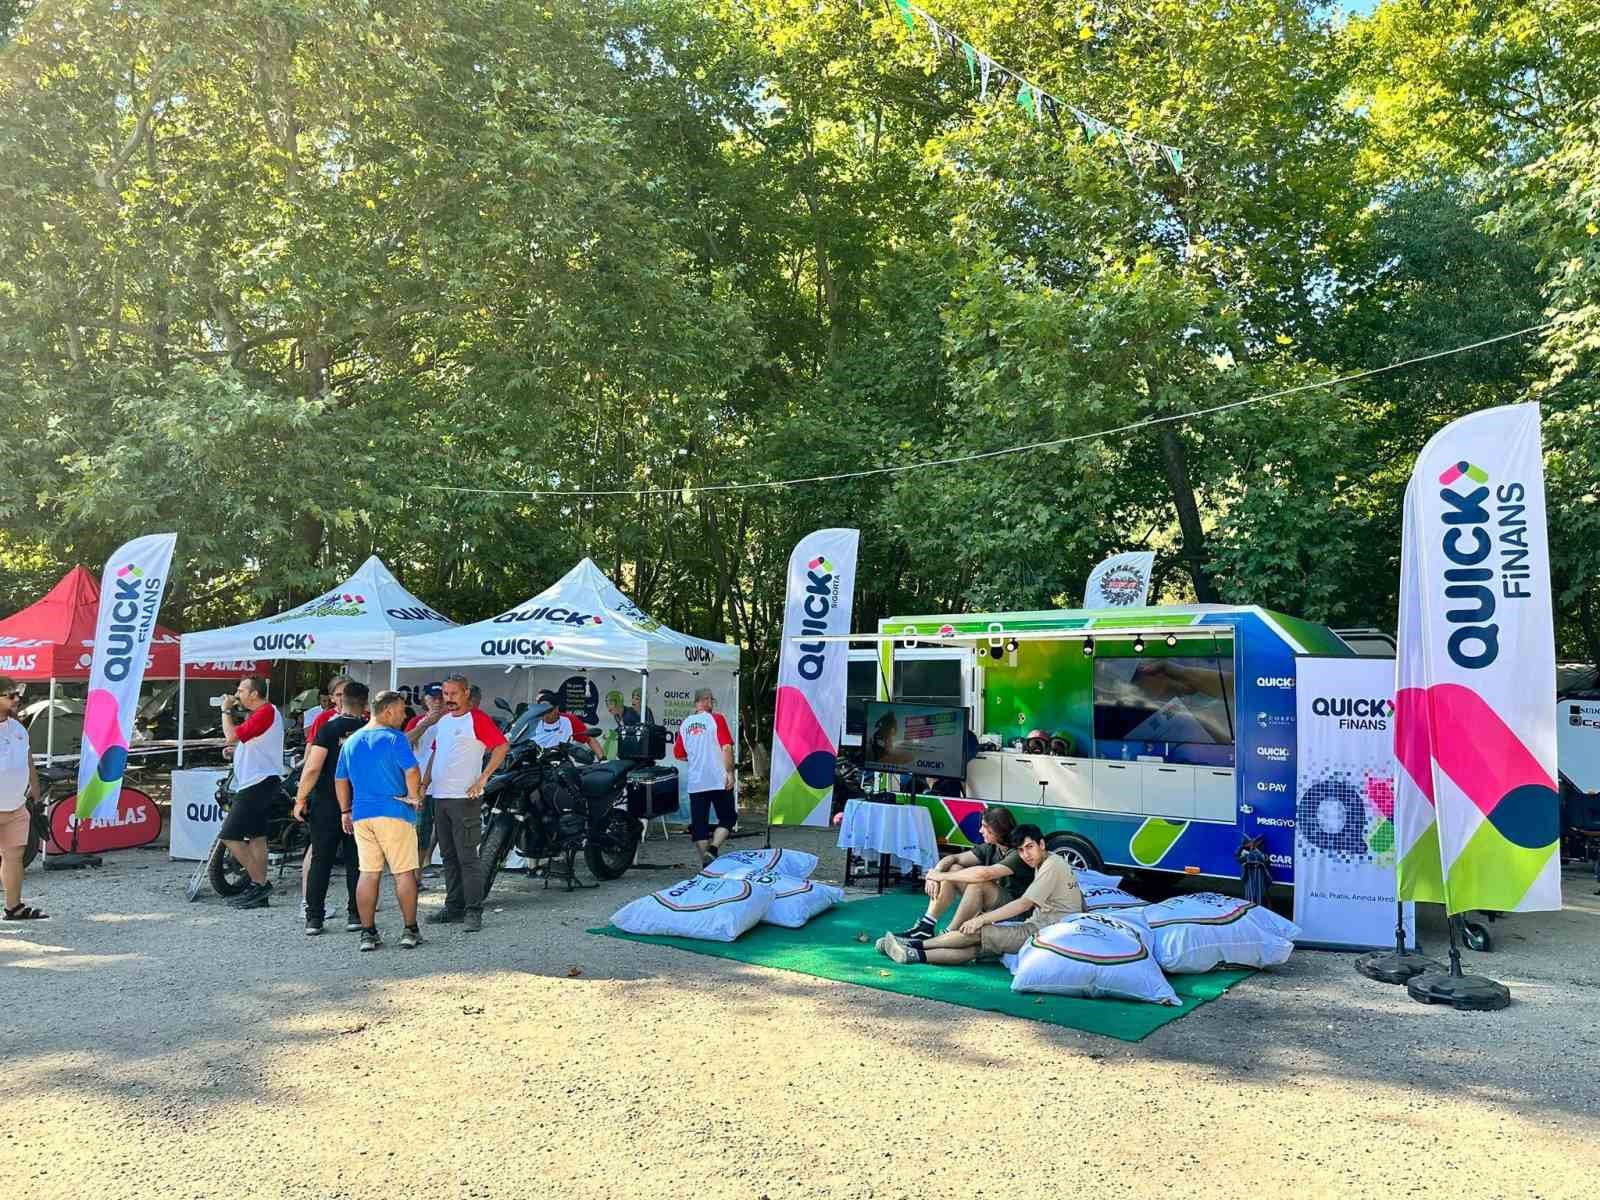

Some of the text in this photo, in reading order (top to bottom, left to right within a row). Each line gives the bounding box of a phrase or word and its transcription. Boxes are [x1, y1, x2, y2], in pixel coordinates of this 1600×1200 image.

[1440, 486, 1499, 669] QUICK
[493, 607, 592, 626] QUICK
[104, 578, 142, 682] QUICK
[797, 570, 833, 681] QUICK
[253, 634, 308, 651] QUICK
[480, 639, 546, 656] QUICK
[685, 646, 712, 662] QUICK
[1256, 676, 1292, 688] QUICK
[664, 690, 690, 699] QUICK
[1312, 697, 1386, 718] QUICK
[1256, 746, 1289, 756] QUICK
[1269, 783, 1287, 792] PAY
